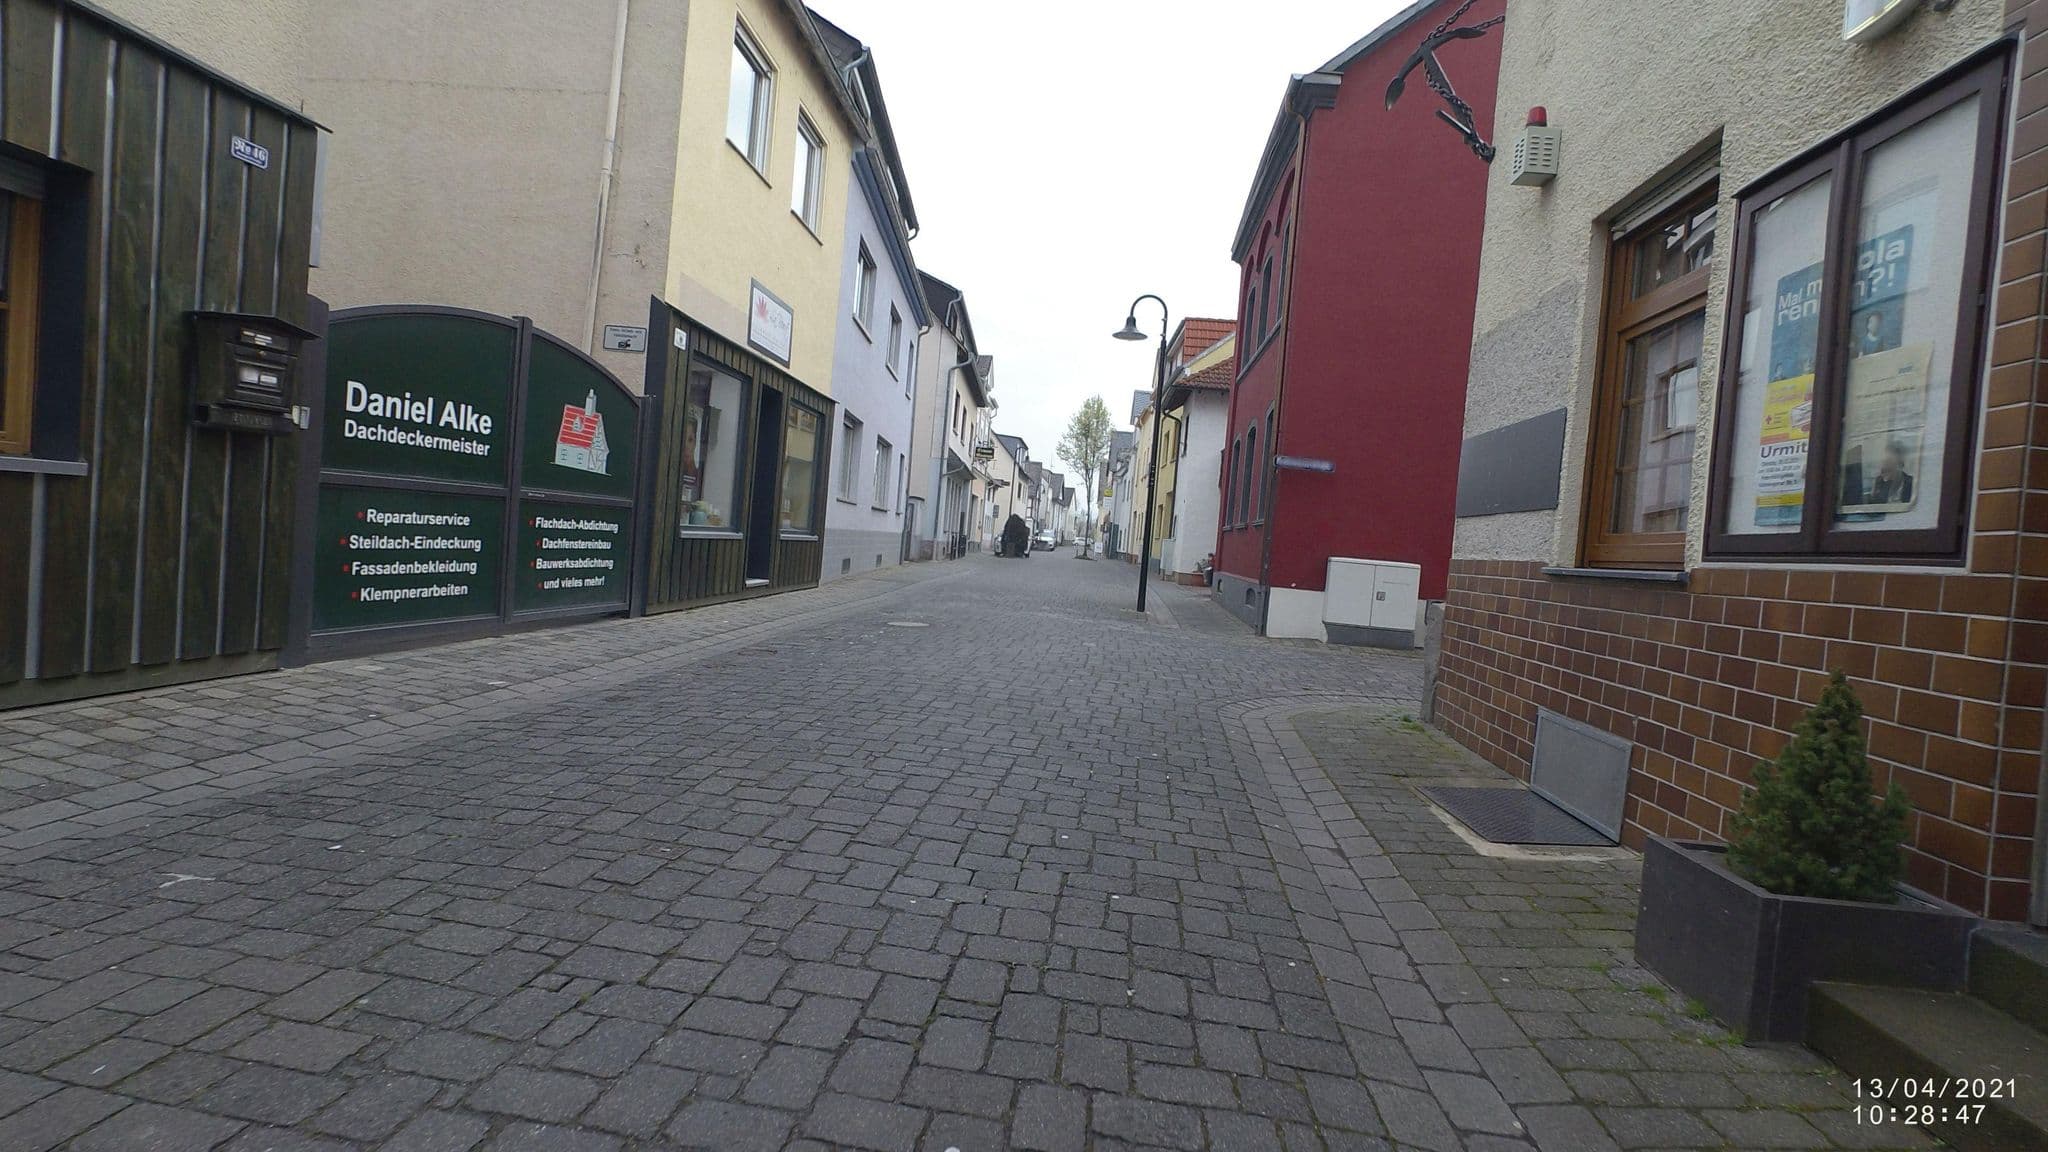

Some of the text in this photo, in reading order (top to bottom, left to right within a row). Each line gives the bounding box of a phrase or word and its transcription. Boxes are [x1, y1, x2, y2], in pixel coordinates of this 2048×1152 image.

[345, 380, 493, 435] Daniel Alke
[344, 418, 491, 457] Dachdeckermeister
[1760, 441, 1809, 459] Urmit
[366, 508, 471, 527] Reparaturservice
[535, 517, 619, 534] Flachdach-Abdichtung
[349, 534, 482, 552] Steildach-Eindeckung
[542, 537, 612, 550] Dachfenstereinbau
[351, 559, 478, 576] Fassadenbekleidung
[535, 557, 614, 570] Bauwerksabdichtung
[543, 578, 560, 590] und
[561, 576, 583, 588] vieles
[360, 583, 469, 602] Klempnerarbeiten
